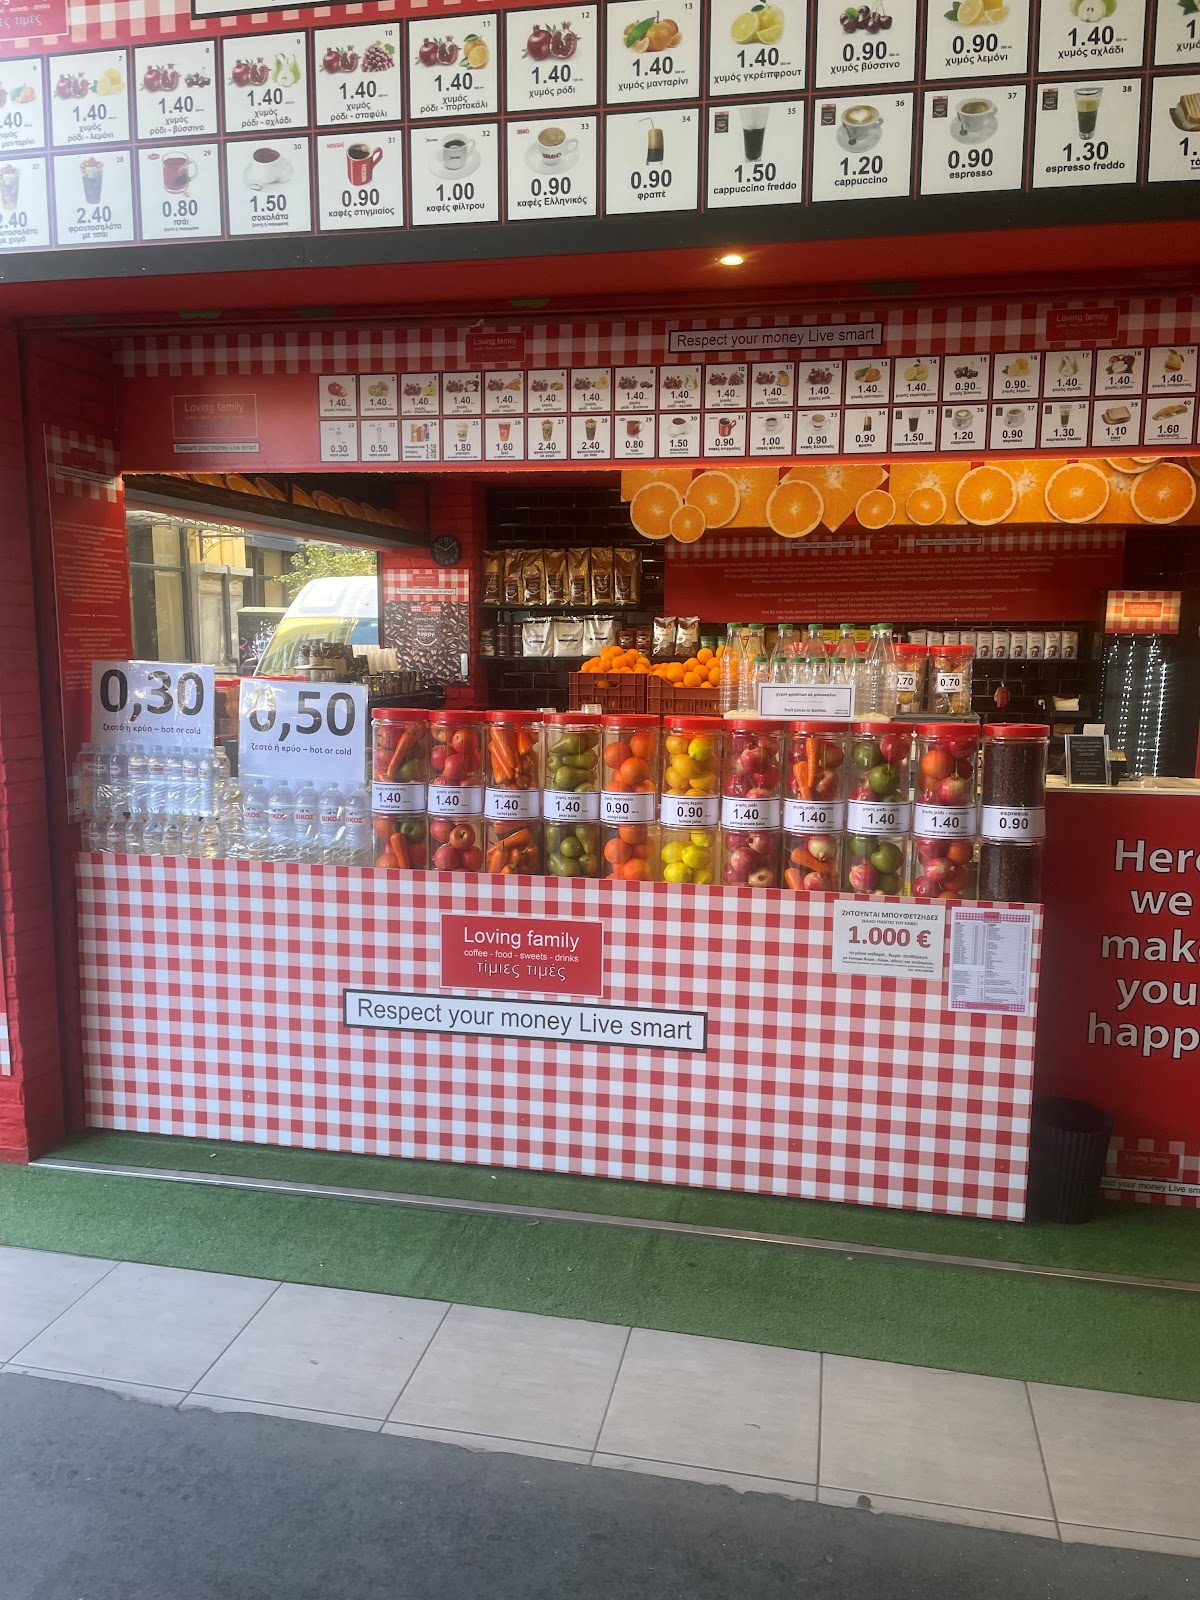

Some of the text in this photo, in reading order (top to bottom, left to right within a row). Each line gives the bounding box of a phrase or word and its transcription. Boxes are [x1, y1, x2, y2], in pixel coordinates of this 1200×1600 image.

[1068, 25, 1114, 47] 1.40
[952, 33, 998, 54] 0.90
[737, 47, 780, 68] 1.40
[842, 41, 887, 62] 0.90
[1058, 46, 1124, 59] χυμός αχλάδι
[945, 52, 1009, 66] χυμός λεμόνι
[632, 56, 673, 77] 1.40
[830, 60, 900, 75] χυμός βύσσινο
[531, 64, 571, 84] 1.40
[714, 69, 802, 84] χυμός γκρέιπφρουτ
[434, 72, 473, 92] 1.40
[618, 78, 688, 92] χυμός μανταρίνι
[247, 88, 283, 107] 1.40
[339, 81, 377, 100] 1.40
[529, 86, 576, 98] χυμός ρόδι
[158, 95, 194, 115] 1.40
[346, 101, 371, 111] χυμός
[442, 94, 468, 104] χυμός
[72, 104, 107, 122] 1.40
[254, 108, 278, 118] χυμός
[420, 101, 488, 114] ρόδι πορτοκάλι
[165, 116, 188, 126] χυμός
[265, 116, 292, 126] αχλάδι
[330, 110, 388, 122] ρόδι σταφύλι
[79, 124, 102, 133] χυμός
[172, 123, 205, 134] βύσσινο
[1063, 141, 1109, 162] 1.30
[840, 155, 883, 176] 1.20
[947, 148, 994, 170] 0.90
[734, 163, 777, 184] 1.50
[949, 169, 993, 179] espresso
[1046, 160, 1125, 174] espresso freddo
[531, 176, 571, 197] 0.90
[630, 169, 672, 190] 0.90
[834, 175, 888, 187] cappuccino
[436, 182, 475, 201] 1.00
[637, 190, 666, 200] φραπέ
[713, 182, 797, 196] cappuccino freddo
[250, 194, 287, 213] 1.50
[341, 188, 380, 208] 0.90
[517, 196, 587, 208] καφές Ελληνικός
[162, 199, 198, 218] 0.80
[328, 206, 395, 219] καφές στιγμιαίος
[426, 201, 485, 213] καφές φίλτρου
[77, 206, 112, 224] 2.40
[251, 213, 289, 222] σοκολάτα
[677, 327, 874, 348] Respect your money Live smart
[955, 382, 975, 390] 0.90
[954, 432, 973, 440] 1.20
[1106, 427, 1126, 436] 1.10
[1158, 425, 1179, 434] 1.60
[941, 679, 960, 687] 0.70
[101, 669, 204, 721] 0,30
[249, 688, 355, 741] 0,50
[161, 724, 174, 733] hot
[251, 743, 272, 751] ζεστό
[378, 793, 400, 803] 1.40
[436, 796, 459, 805] 1.40
[495, 800, 518, 810] 1.40
[556, 802, 580, 812] 1.40
[607, 803, 629, 813] 0.90
[677, 807, 703, 817] 0.90
[734, 809, 759, 819] 1.40
[800, 812, 826, 823] 1.40
[868, 812, 895, 823] 1.40
[932, 817, 959, 828] 1.40
[1000, 818, 1028, 829] 0.90
[1130, 890, 1193, 916] we
[464, 927, 579, 952] Loving family
[849, 926, 931, 948] 1.000 €
[1101, 928, 1200, 962] mak
[495, 950, 512, 958] food
[555, 954, 578, 962] drinks
[477, 960, 566, 981] τίμιες τιμές
[1116, 978, 1197, 1010] you
[359, 999, 692, 1040] Respect your money Live smart
[1088, 1011, 1200, 1058] happ
[1119, 1180, 1136, 1188] your
[1139, 1183, 1166, 1192] money
